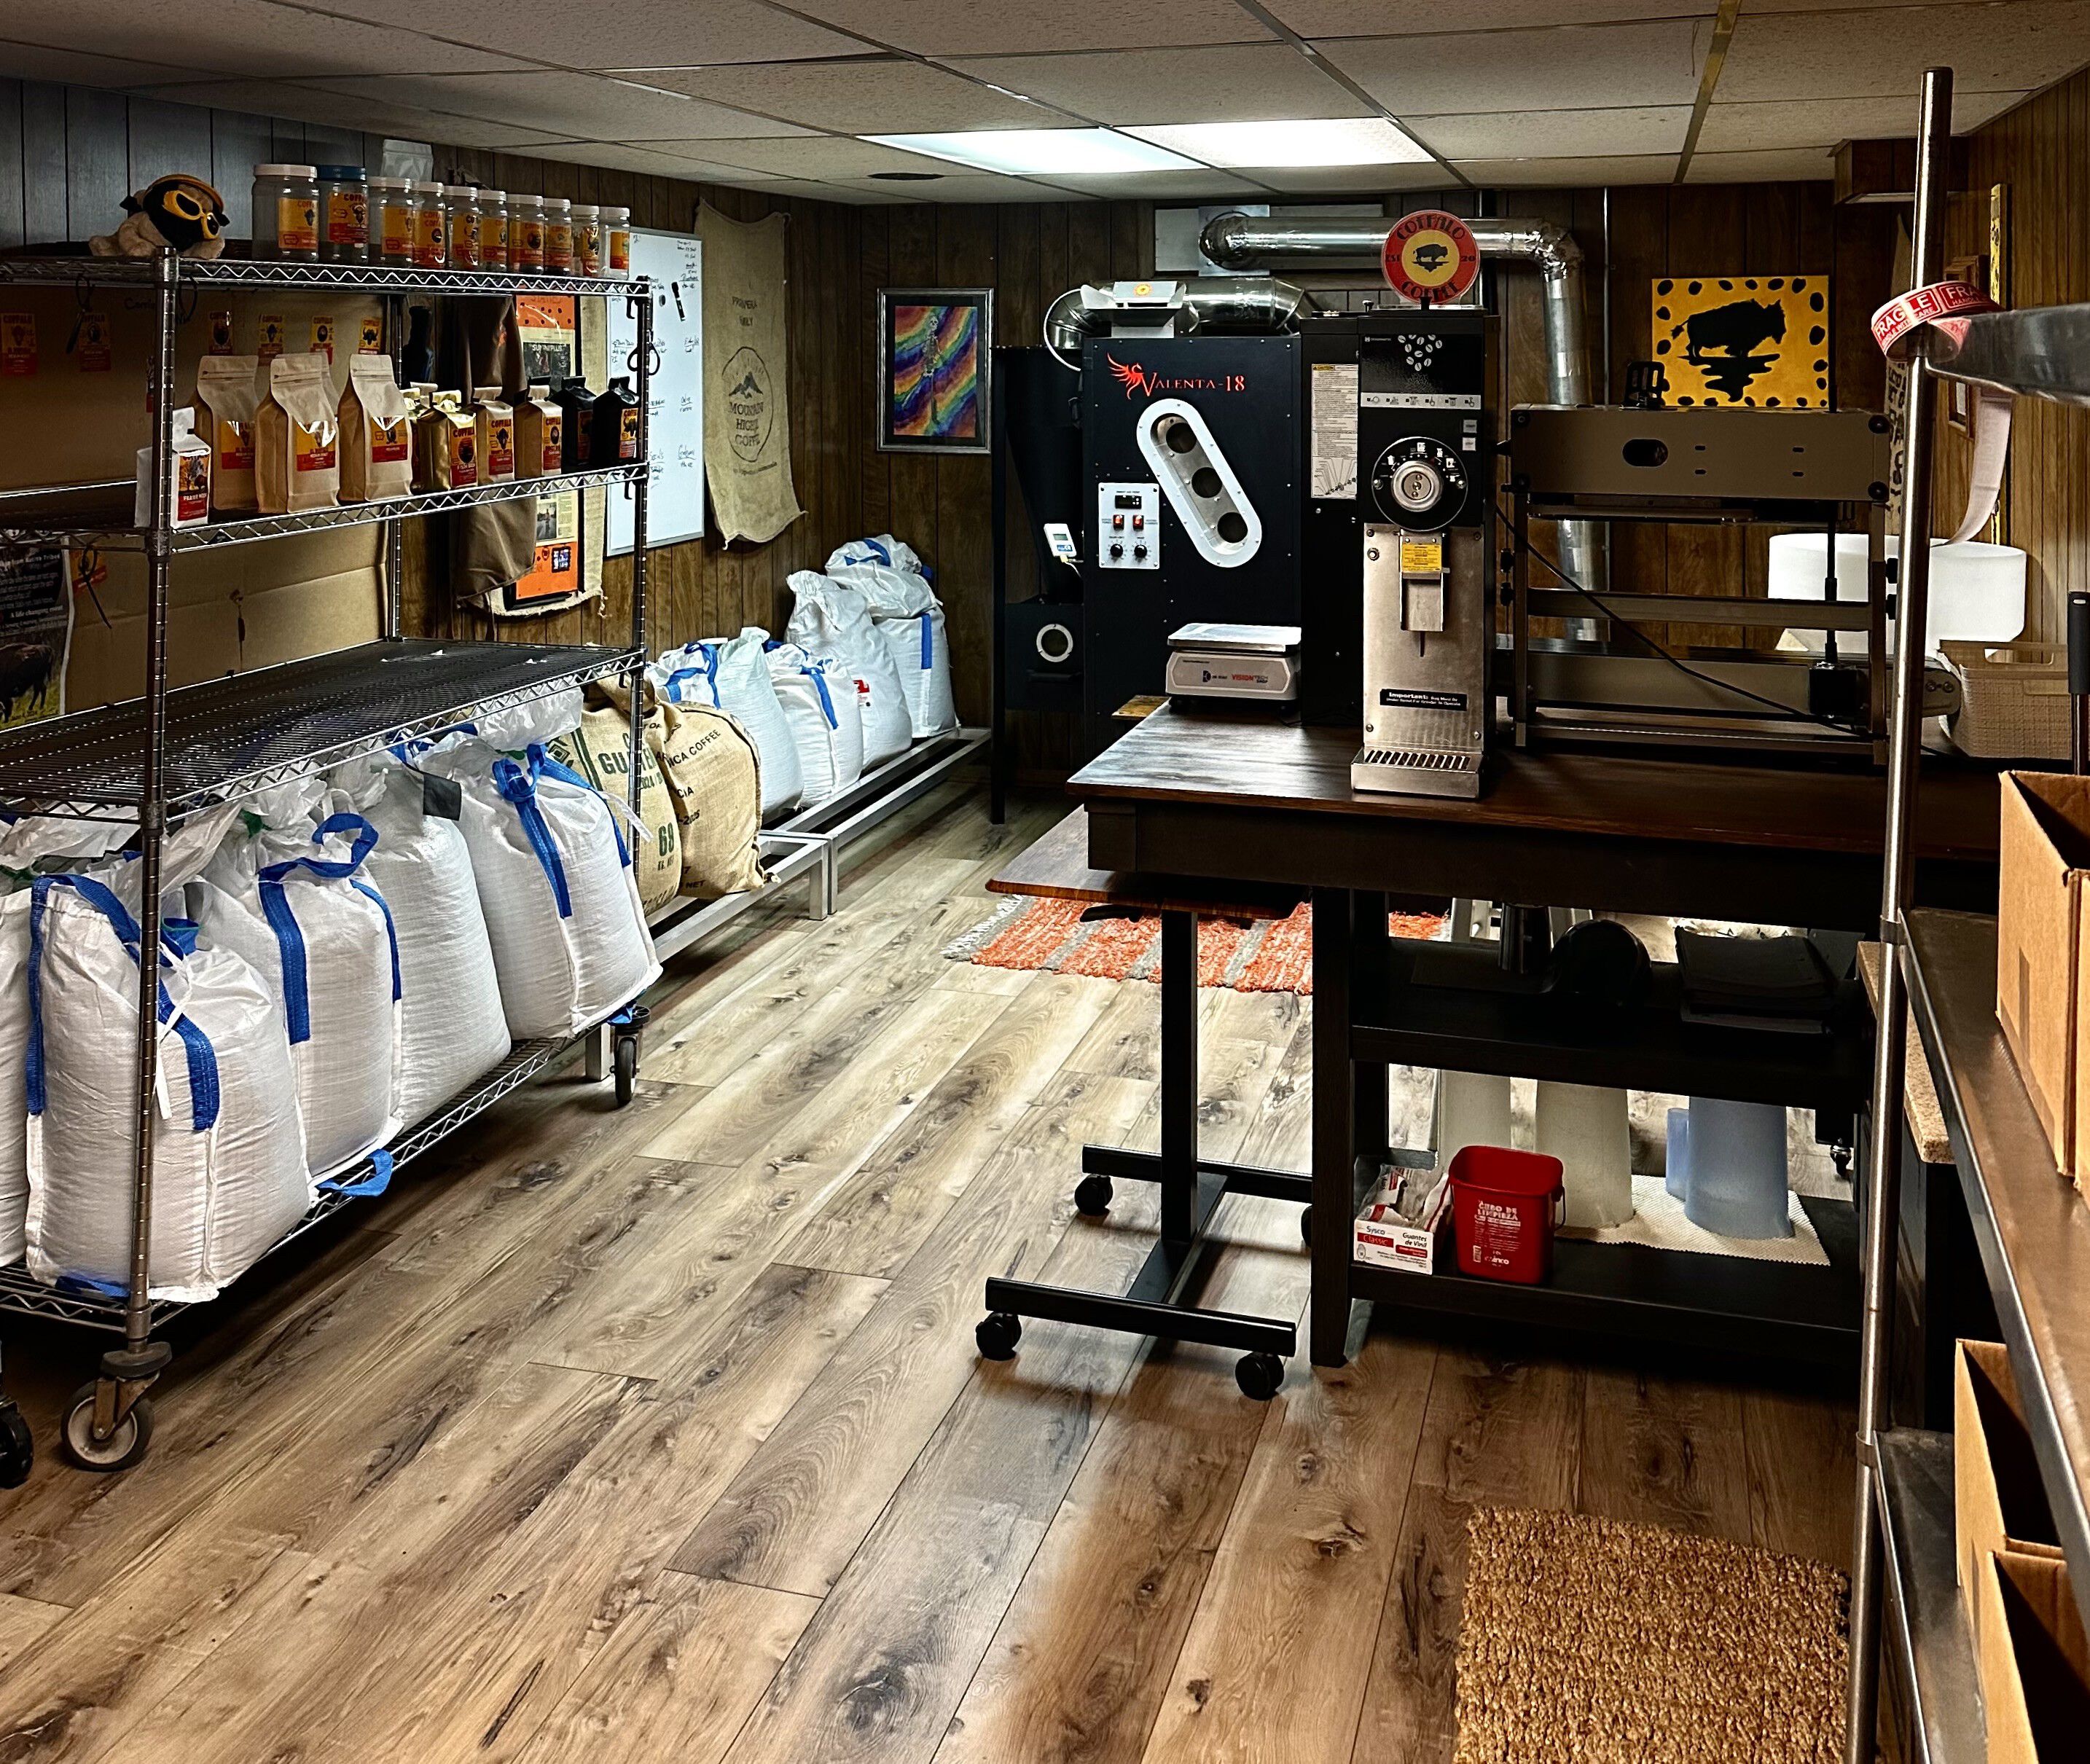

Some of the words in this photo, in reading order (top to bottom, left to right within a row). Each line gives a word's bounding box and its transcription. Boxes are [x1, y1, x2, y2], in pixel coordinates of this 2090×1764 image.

[1396, 213, 1465, 240] COFFALO
[1875, 294, 1932, 339] FRAGLE
[689, 729, 721, 756] COFFEE
[1366, 1226, 1386, 1235] Sysco
[1402, 1232, 1428, 1242] Guantes
